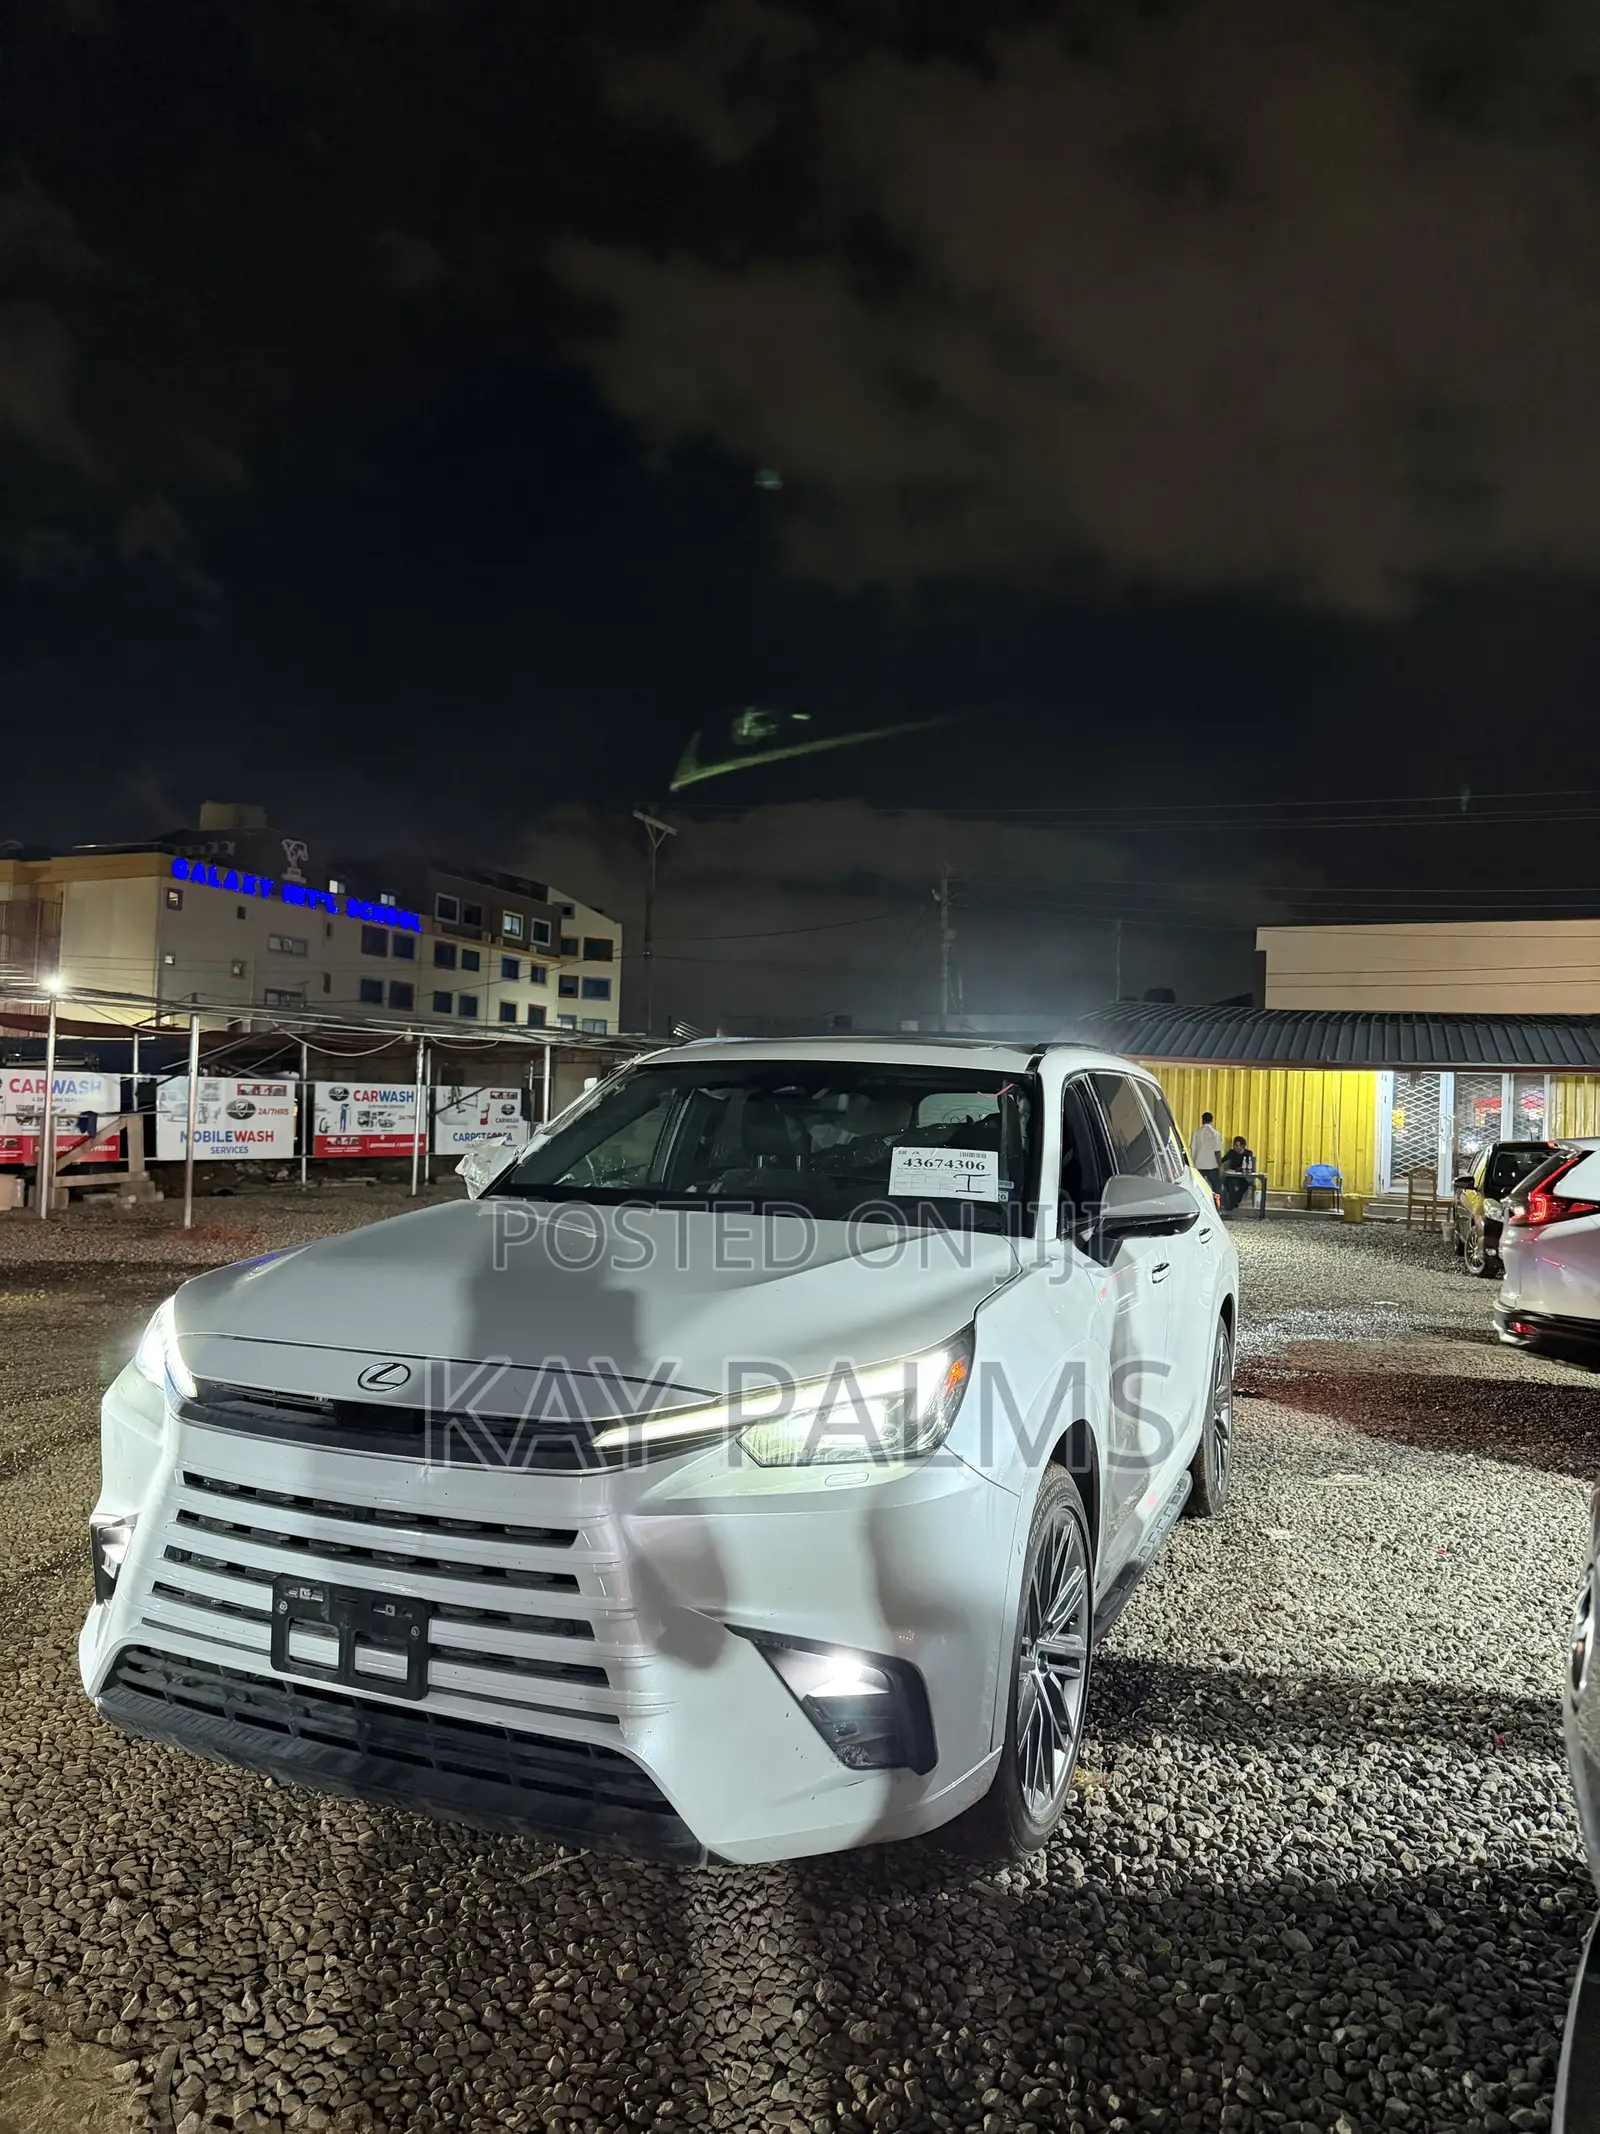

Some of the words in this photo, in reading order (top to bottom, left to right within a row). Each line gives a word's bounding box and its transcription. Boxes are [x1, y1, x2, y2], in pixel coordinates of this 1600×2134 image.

[171, 857, 274, 899] GALAXY
[346, 897, 423, 932] SCHOOL
[9, 1078, 102, 1095] CARWASH
[353, 1090, 414, 1102] CARWASH
[258, 1107, 289, 1115] 24/7HRS
[180, 1130, 274, 1143] MOBILEWASH
[210, 1146, 248, 1154] SERVICES
[903, 1158, 985, 1170] 43674306
